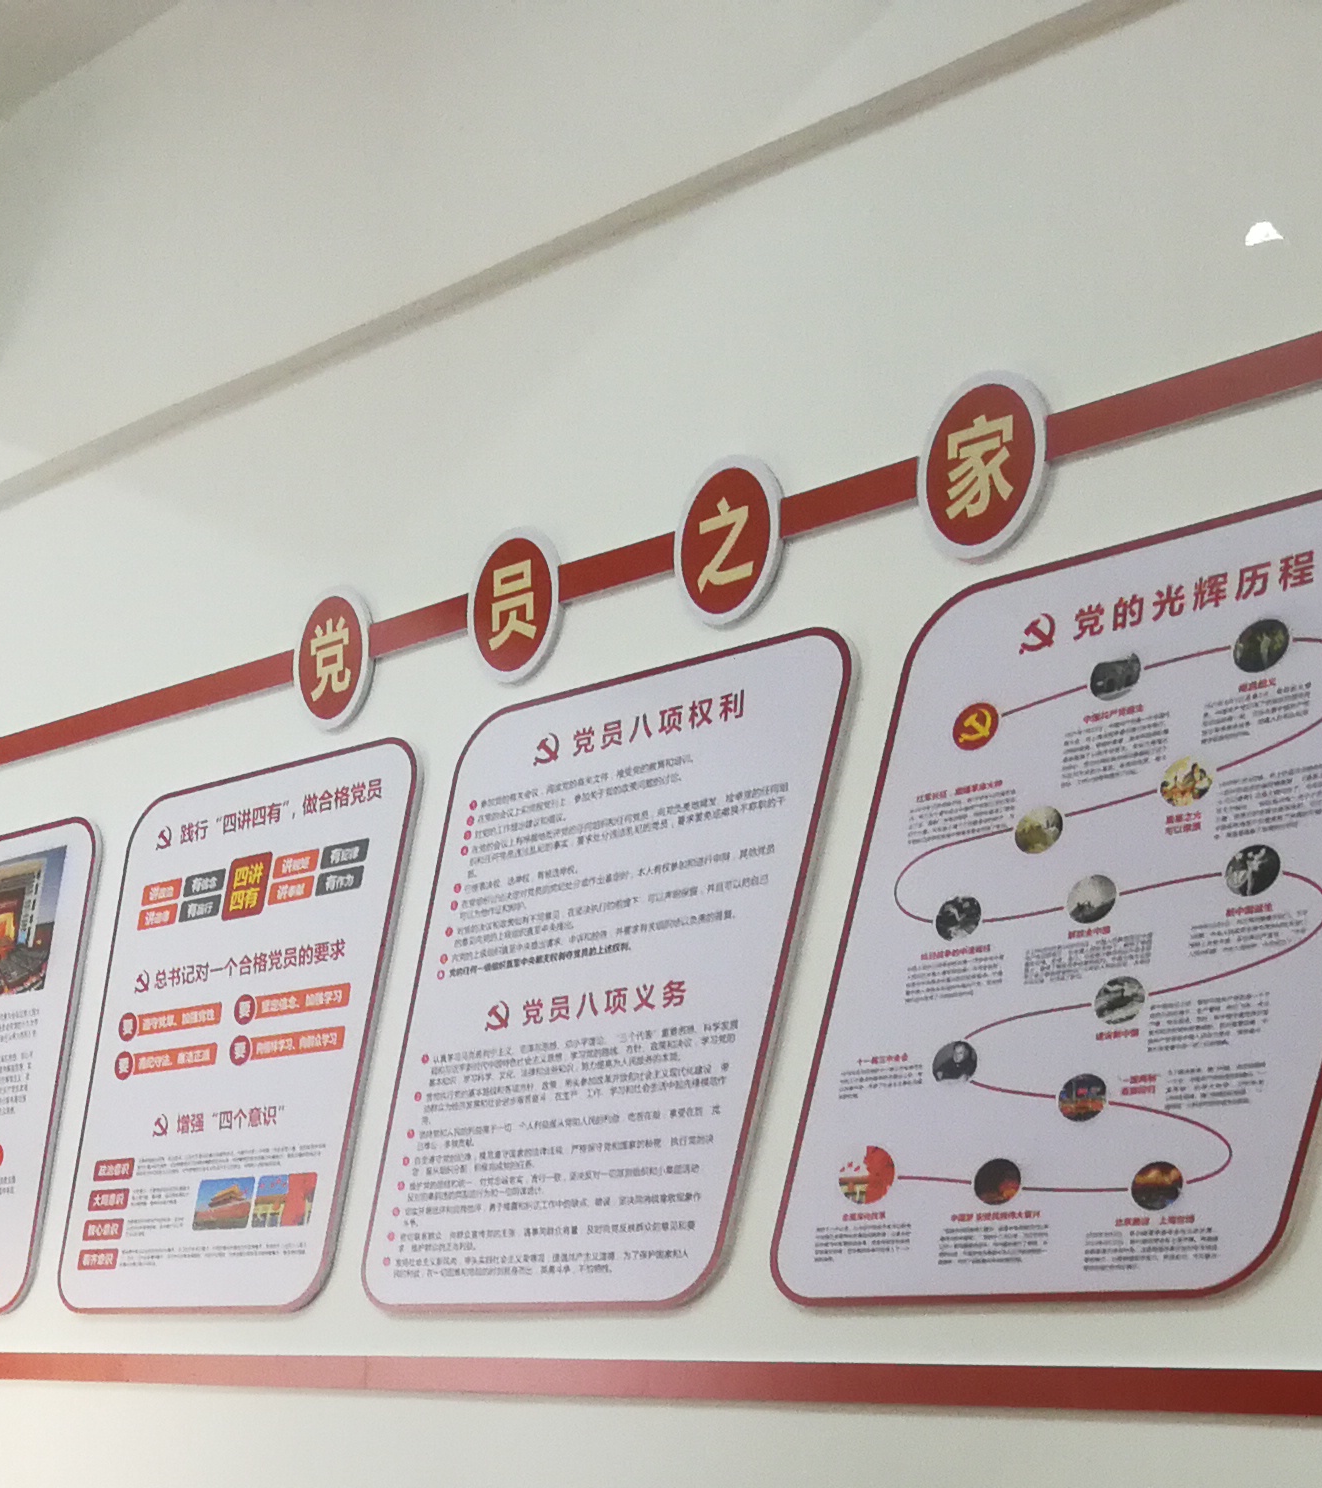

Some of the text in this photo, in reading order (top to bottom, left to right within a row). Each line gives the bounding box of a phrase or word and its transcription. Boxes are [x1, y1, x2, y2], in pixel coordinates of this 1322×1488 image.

[1073, 550, 1315, 640] 党的光辉历程
[573, 688, 745, 758] 党员八项权利
[229, 887, 260, 911] 四有
[233, 863, 264, 888] 四讲
[154, 938, 346, 990] 总书记对一个合格党员的要求
[522, 978, 688, 1026] 党员八项义务
